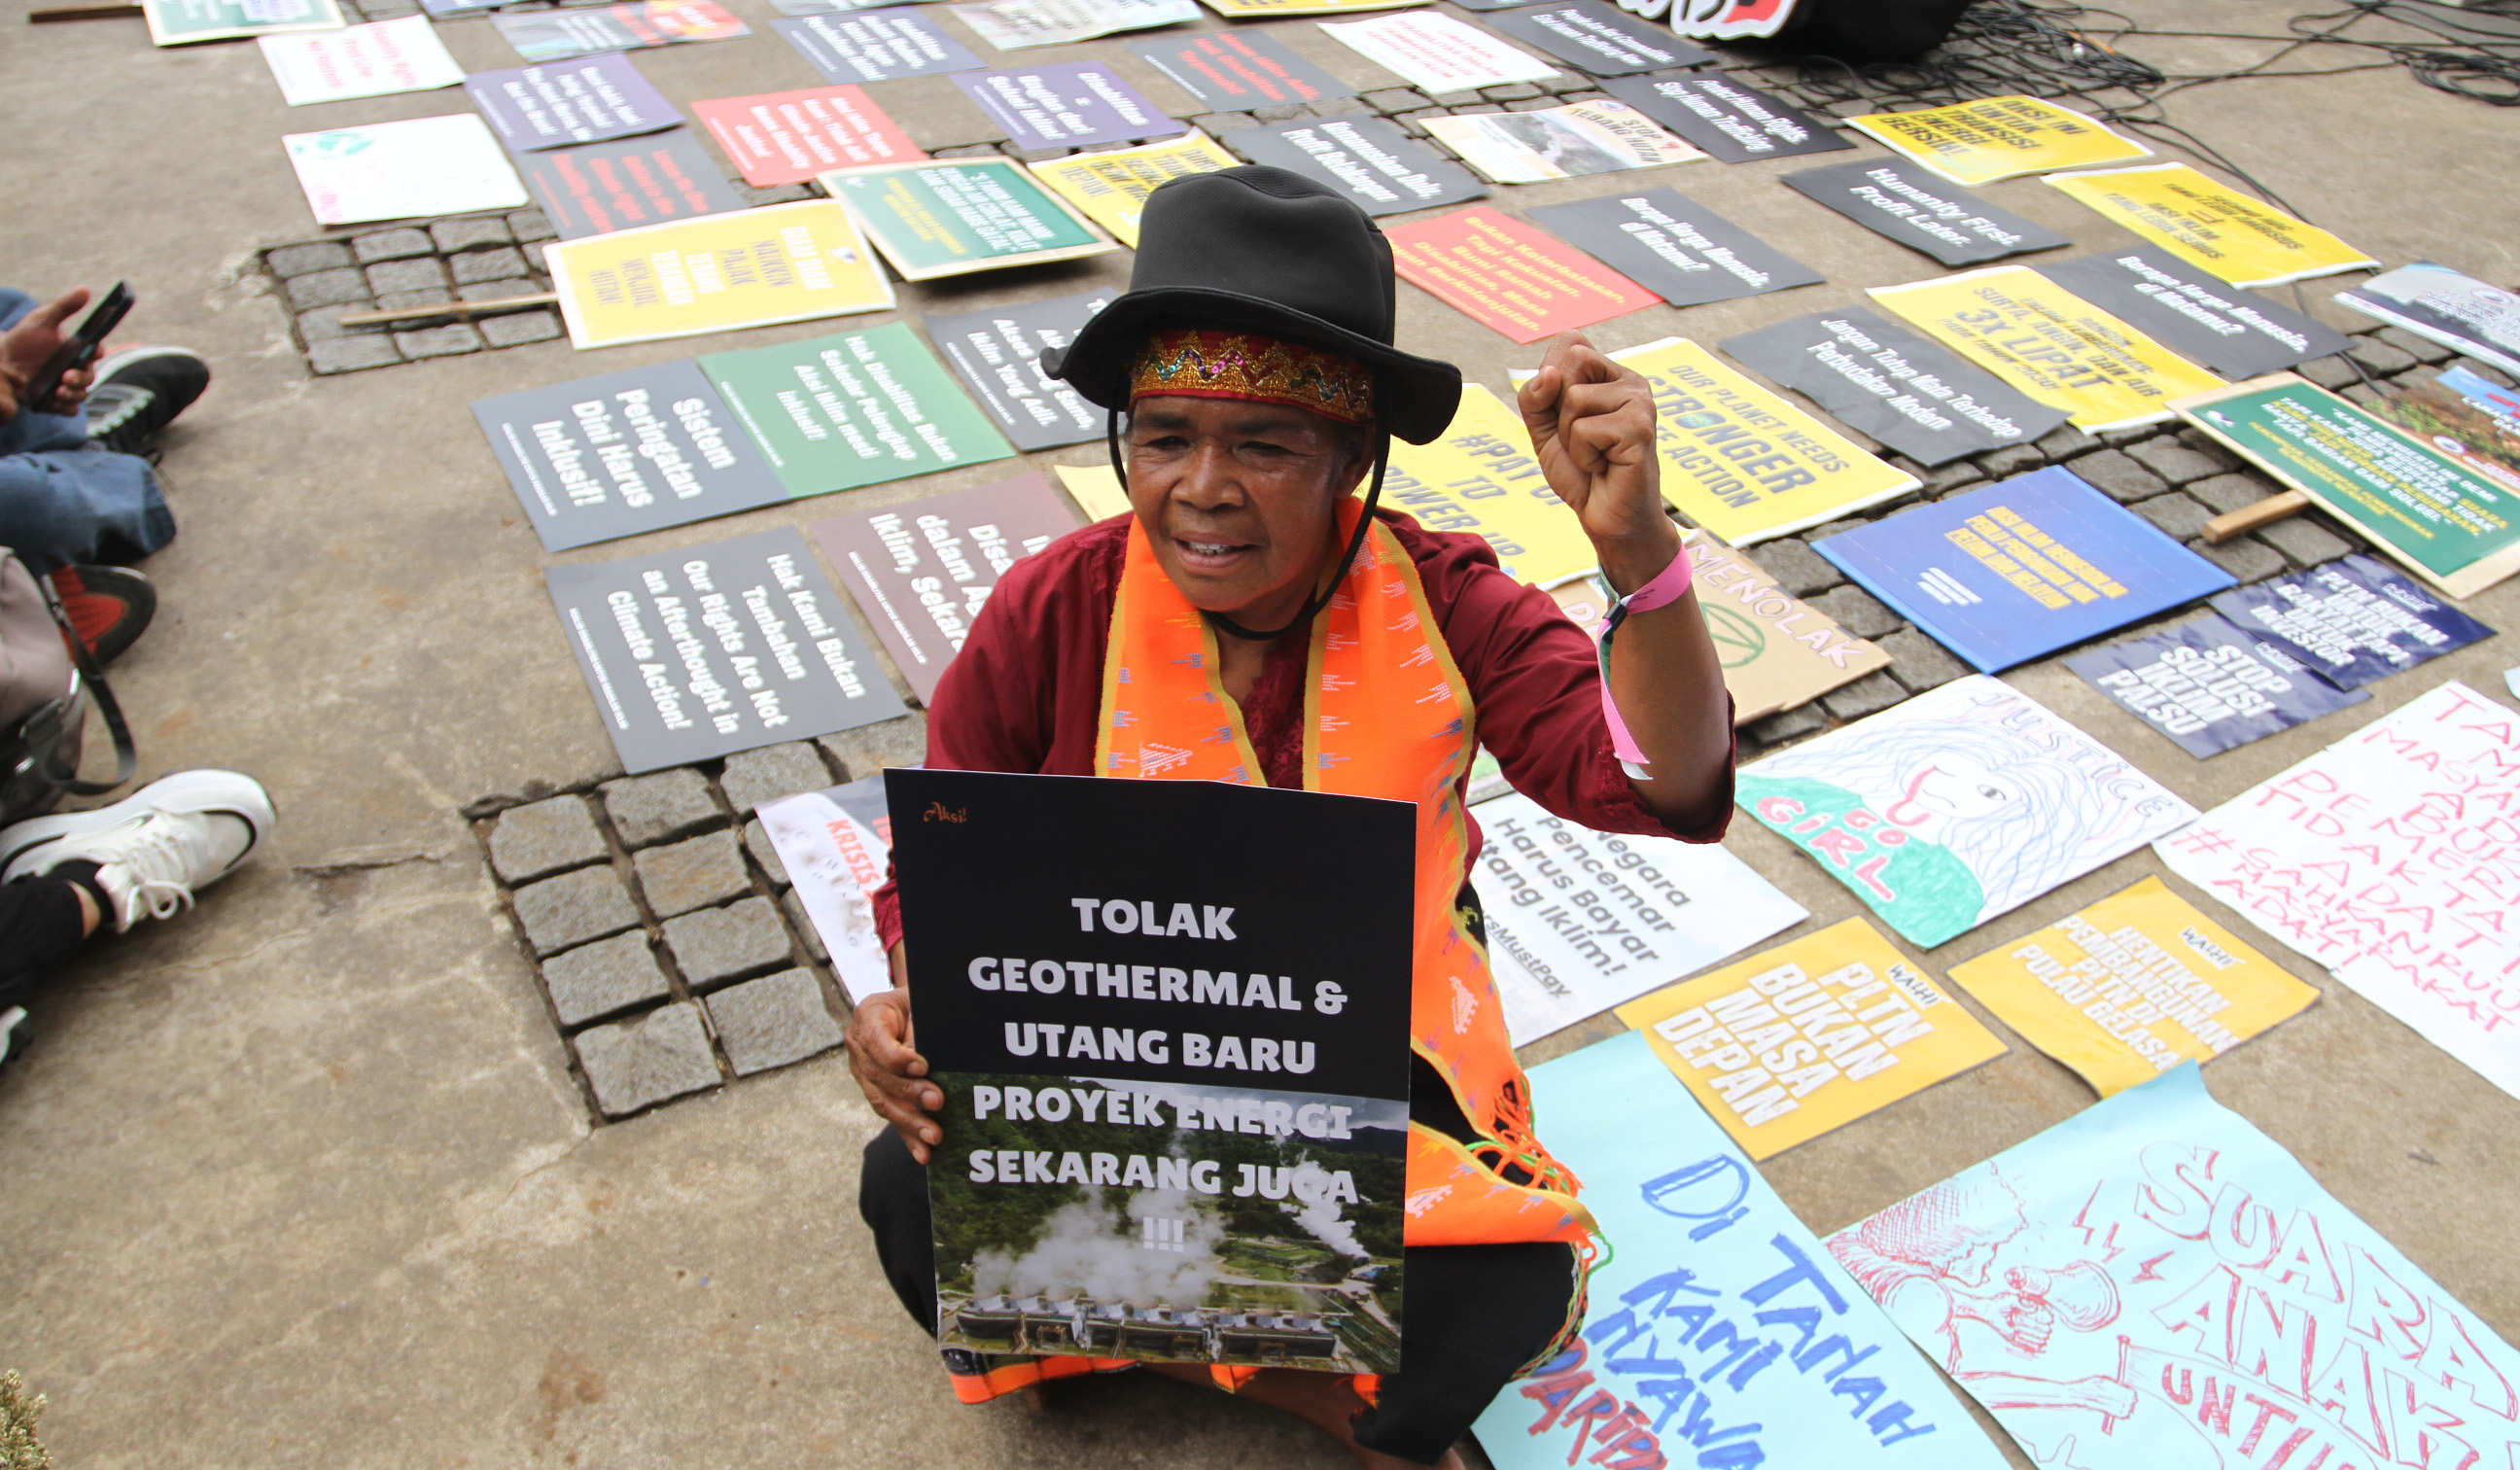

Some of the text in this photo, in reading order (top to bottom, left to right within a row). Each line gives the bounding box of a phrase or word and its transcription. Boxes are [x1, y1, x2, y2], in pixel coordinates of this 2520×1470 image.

[1623, 118, 1663, 140] STOP
[1670, 92, 1733, 118] Human
[1692, 79, 1774, 121] Protect Human
[1908, 113, 1990, 145] ENERGI
[1940, 108, 2041, 150] TRANSISI
[1968, 103, 2046, 134] UNTUK
[1998, 99, 2055, 121] AKSI
[1280, 127, 1398, 202] Profit Belakangan
[1319, 121, 1411, 177] Kemanusiaan
[1568, 108, 1663, 163] TEBANG HUTAN
[1620, 196, 1713, 250] Berapa Harga
[1849, 185, 1971, 245] Profit Later.
[1866, 167, 1969, 220] Humanity
[779, 225, 833, 290] DIAM DIAM
[1463, 215, 1515, 245] Bukan
[1465, 232, 1504, 256] Tapi
[1632, 228, 1710, 271] Matamu?
[2182, 217, 2221, 240] IKLIM
[685, 251, 725, 294] TERANG
[722, 248, 756, 285] PAJAK
[1451, 244, 1553, 299] Bumi Ramah
[2116, 255, 2233, 310] Berapa Harga
[992, 318, 1034, 358] Akses
[1973, 286, 2163, 398] SURYA, AIR
[2152, 290, 2245, 335] Matamu?
[792, 365, 828, 392] Aksi
[966, 331, 1003, 365] Iklim
[995, 363, 1032, 398] Yang
[1019, 397, 1058, 426] Adil.
[1806, 339, 1897, 396] Perbudakan
[1820, 318, 2022, 438] Jangan Tutup Mata Terhadap
[1954, 307, 2114, 389] 3x LIPAT
[844, 334, 957, 462] Hak Disabilitas Bukan
[856, 396, 916, 460] Pelengkap
[1667, 364, 1850, 472] OUR PLANET NEEDS
[532, 420, 605, 506] Inklusif!
[571, 399, 653, 508] Dini Harus
[614, 388, 702, 498] Peringatan
[672, 397, 735, 469] Sistem
[2309, 413, 2349, 436] KAMI
[2346, 433, 2385, 457] JUGA
[1446, 474, 1508, 509] TO
[1665, 440, 1761, 509] ACTION
[2411, 480, 2453, 506] KAMI
[868, 512, 919, 573] Iklim,
[916, 514, 975, 581] dalam
[1985, 505, 2054, 548] AKSI IKLIM
[1965, 514, 2099, 603] PERLU HAK
[741, 584, 805, 680] Tambahan
[766, 553, 864, 698] Hak Kami Bukan
[1687, 541, 1866, 669] MENOLAK
[2249, 604, 2355, 666] INVESTOR
[2275, 583, 2365, 636] RAKYAT
[2318, 590, 2408, 640] UNTUK
[2362, 599, 2448, 645] BUKAN
[607, 590, 692, 729] Climate Action!
[641, 569, 739, 734] an Afterthought in
[682, 559, 788, 727] Our Rights Are Not
[2193, 644, 2292, 693] STOP
[2097, 669, 2209, 734] PALSU
[2127, 661, 2244, 722] IKLIM
[2147, 643, 2290, 719] SOLUSI
[924, 801, 967, 824] Aksi!
[1843, 807, 1907, 848] GO
[2256, 785, 2427, 887] TIDAK
[826, 819, 880, 885] KRISIS
[1536, 816, 1676, 932] Pencemar
[1071, 897, 1237, 941] TOLAK
[1494, 817, 1574, 890] Harus
[1570, 889, 1660, 962] Bayar
[2240, 848, 2430, 956] SAHKAN
[1538, 904, 1628, 977] Iklim!
[2108, 925, 2232, 1016] HENTIKAN
[2232, 863, 2515, 1032] MASYARAKAT
[967, 956, 1348, 1015] GEOTHERMAL &
[1817, 962, 1934, 1047] PLTN
[2011, 943, 2182, 1071] PULAU GELASA
[2052, 914, 2242, 1054] PEMBANGUNAN
[2070, 956, 2169, 1027] PLTN DI
[1004, 1021, 1316, 1074] UTANG BARU
[1702, 987, 1838, 1097] MASA
[1750, 962, 1898, 1080] BUKAN
[1655, 1006, 1798, 1126] DEPAN
[972, 1086, 1351, 1140] PROYEK ENERGI
[968, 1150, 1359, 1207] SEKARANG JUGA
[1142, 1216, 1184, 1253] !!!
[2134, 1140, 2518, 1421] SUARA
[1740, 1232, 1937, 1447] TANAH
[2150, 1263, 2480, 1470] ANAK
